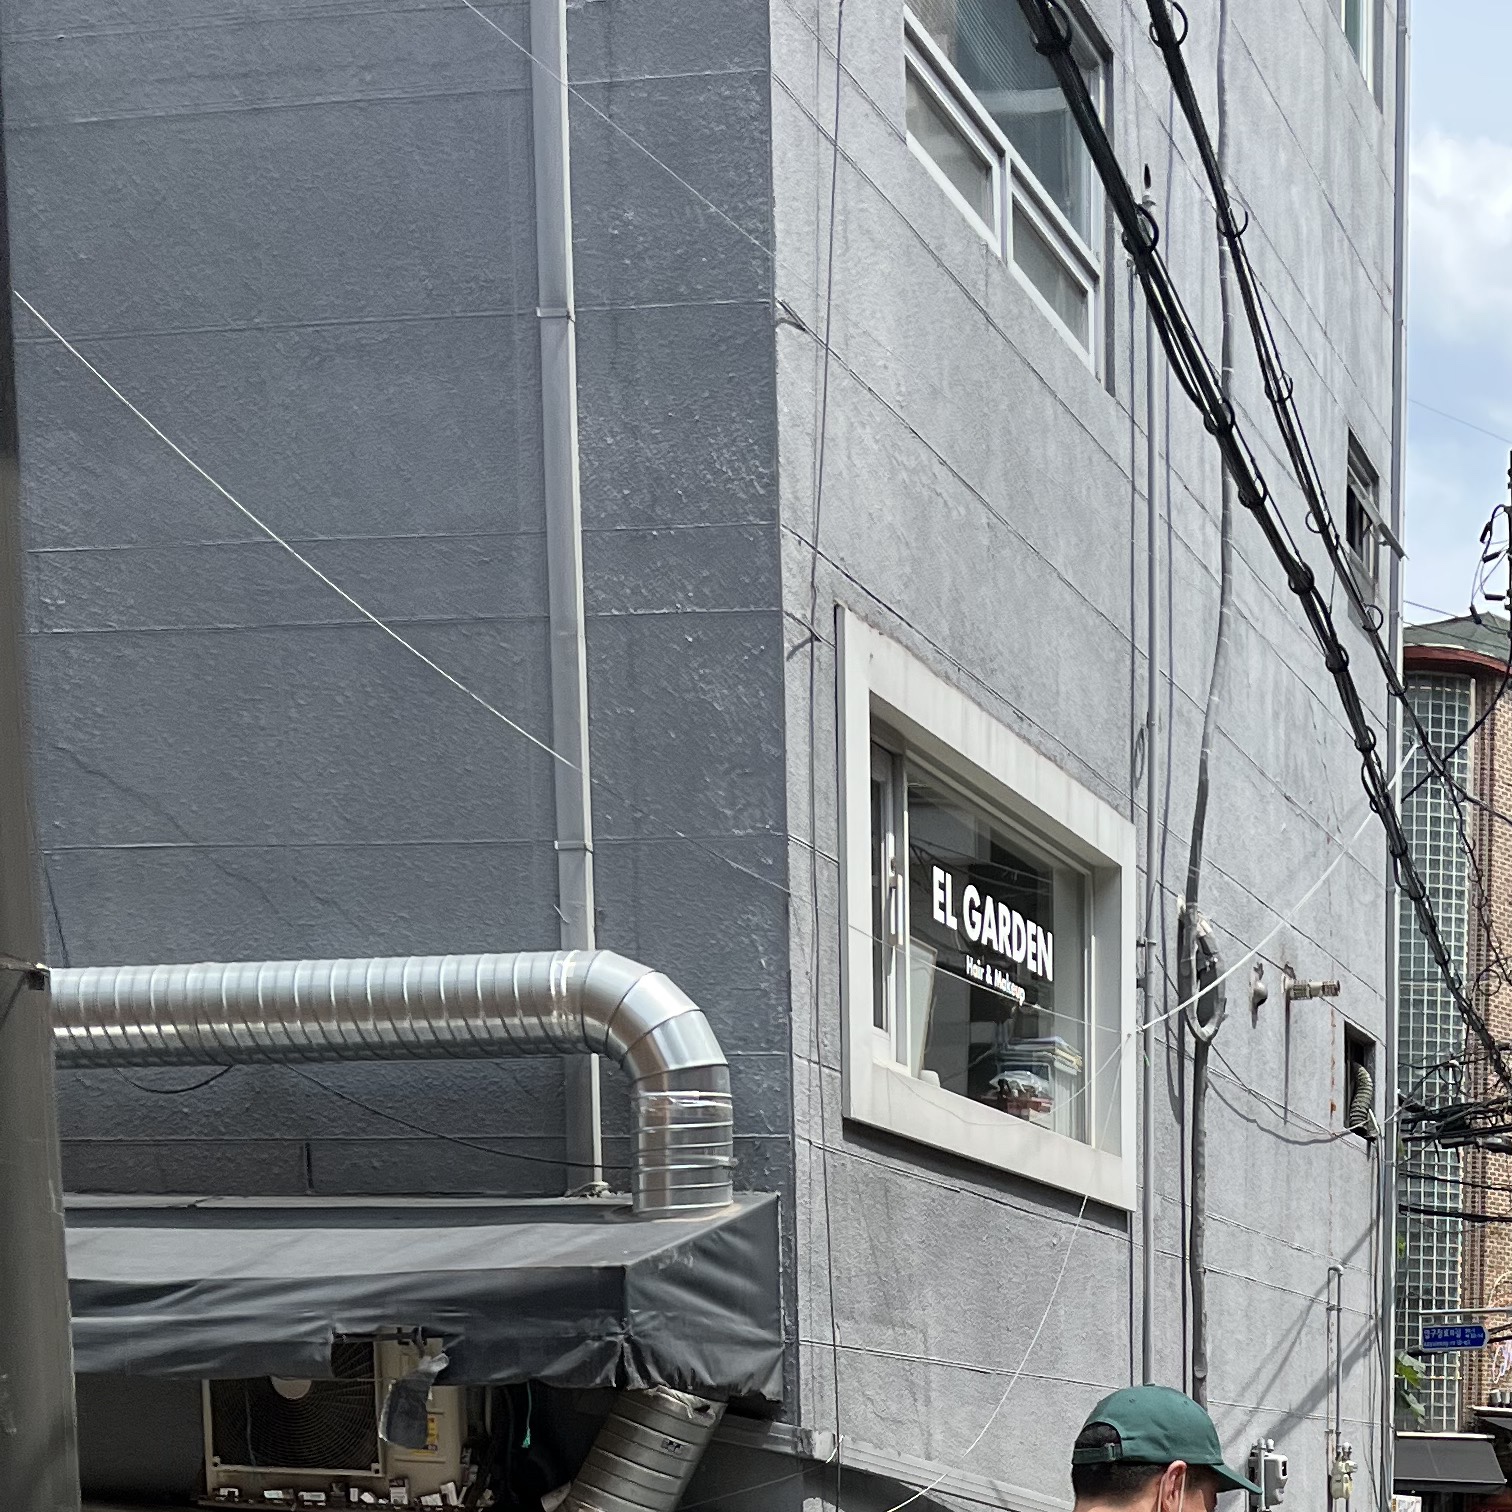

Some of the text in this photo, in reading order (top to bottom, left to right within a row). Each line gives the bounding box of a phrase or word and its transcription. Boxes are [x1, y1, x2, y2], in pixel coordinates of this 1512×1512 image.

[932, 865, 1054, 982] EL GARDEN
[966, 954, 1026, 1007] Hair & Makeup
